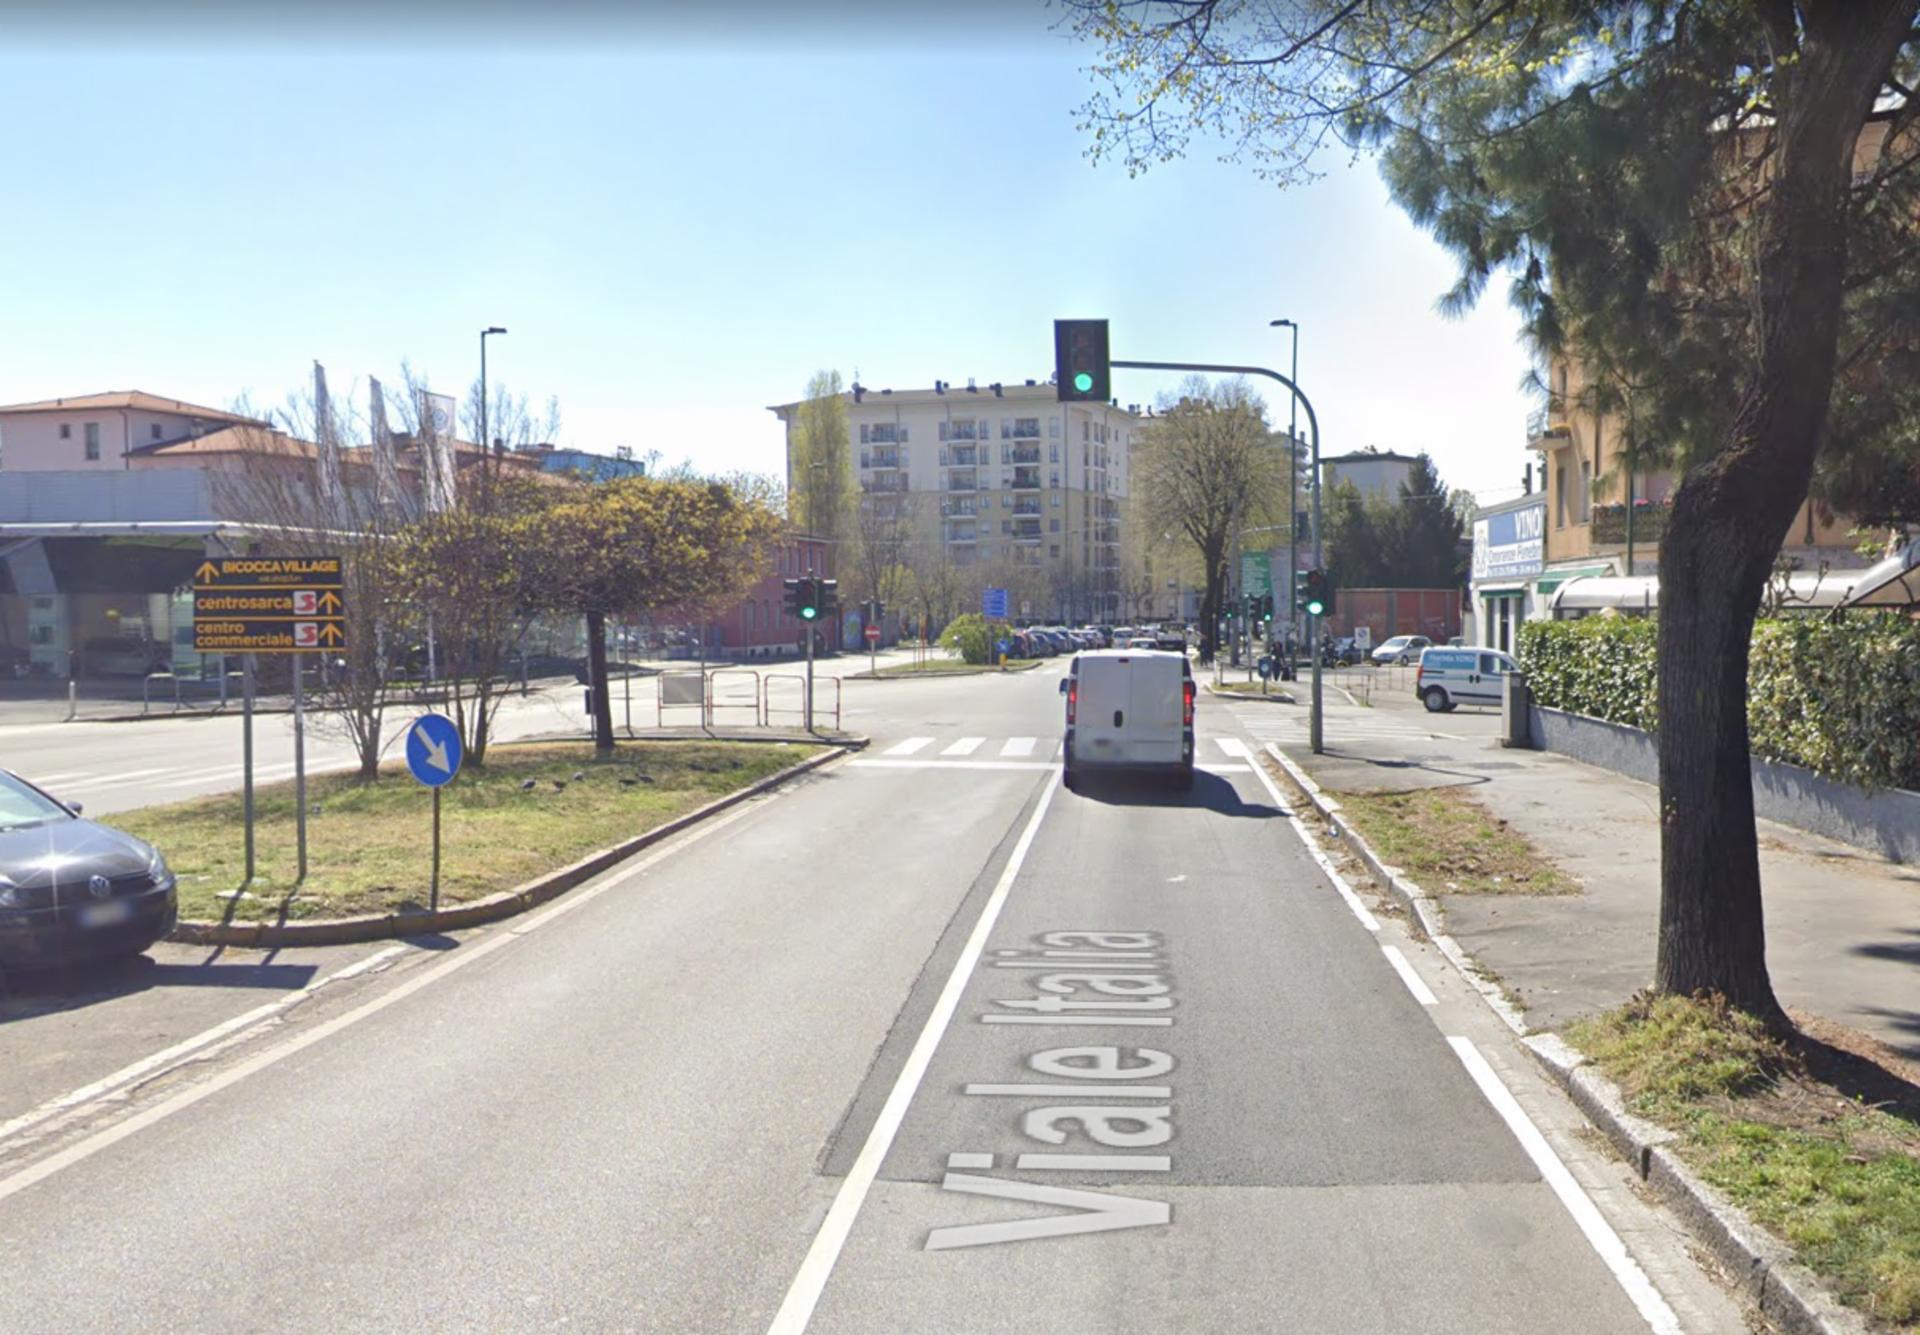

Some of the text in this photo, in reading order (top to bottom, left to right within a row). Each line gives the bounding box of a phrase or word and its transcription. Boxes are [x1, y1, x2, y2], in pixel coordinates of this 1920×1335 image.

[1514, 506, 1541, 541] VINO
[222, 560, 339, 574] BICOCCA VILLAGE
[196, 596, 293, 610] centrosarca
[196, 622, 245, 634] centro
[196, 633, 293, 646] commerciale
